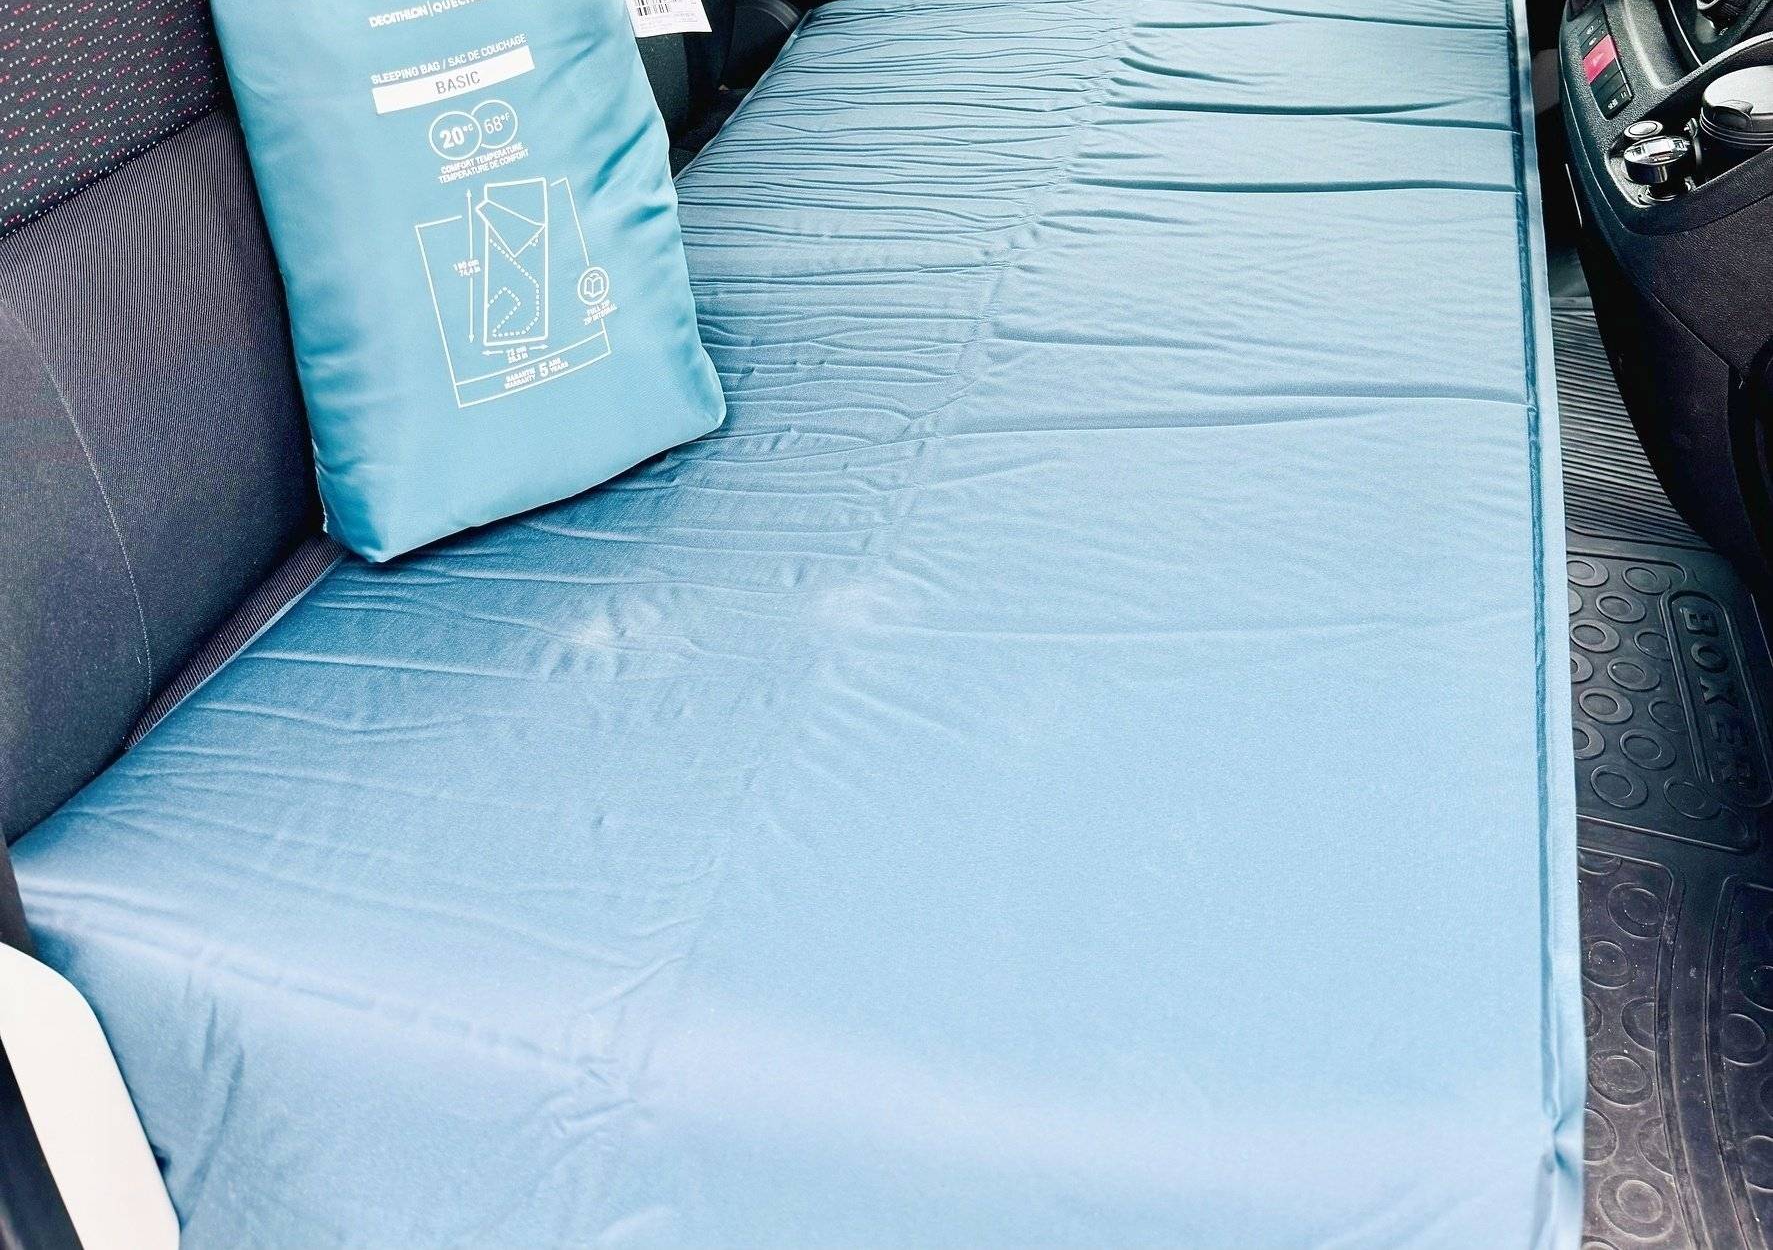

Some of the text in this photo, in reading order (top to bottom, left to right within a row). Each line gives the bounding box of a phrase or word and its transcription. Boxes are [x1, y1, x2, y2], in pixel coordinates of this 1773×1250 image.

[368, 4, 429, 28] DECATHLON
[370, 67, 419, 85] SLEEPING
[420, 61, 441, 75] BAG
[447, 53, 467, 68] SAC
[467, 49, 481, 62] DE
[480, 33, 528, 57] COUCHAGE
[435, 71, 481, 95] BASIC
[440, 157, 476, 175] COMFORT
[489, 159, 500, 170] DE
[539, 361, 549, 377] 5
